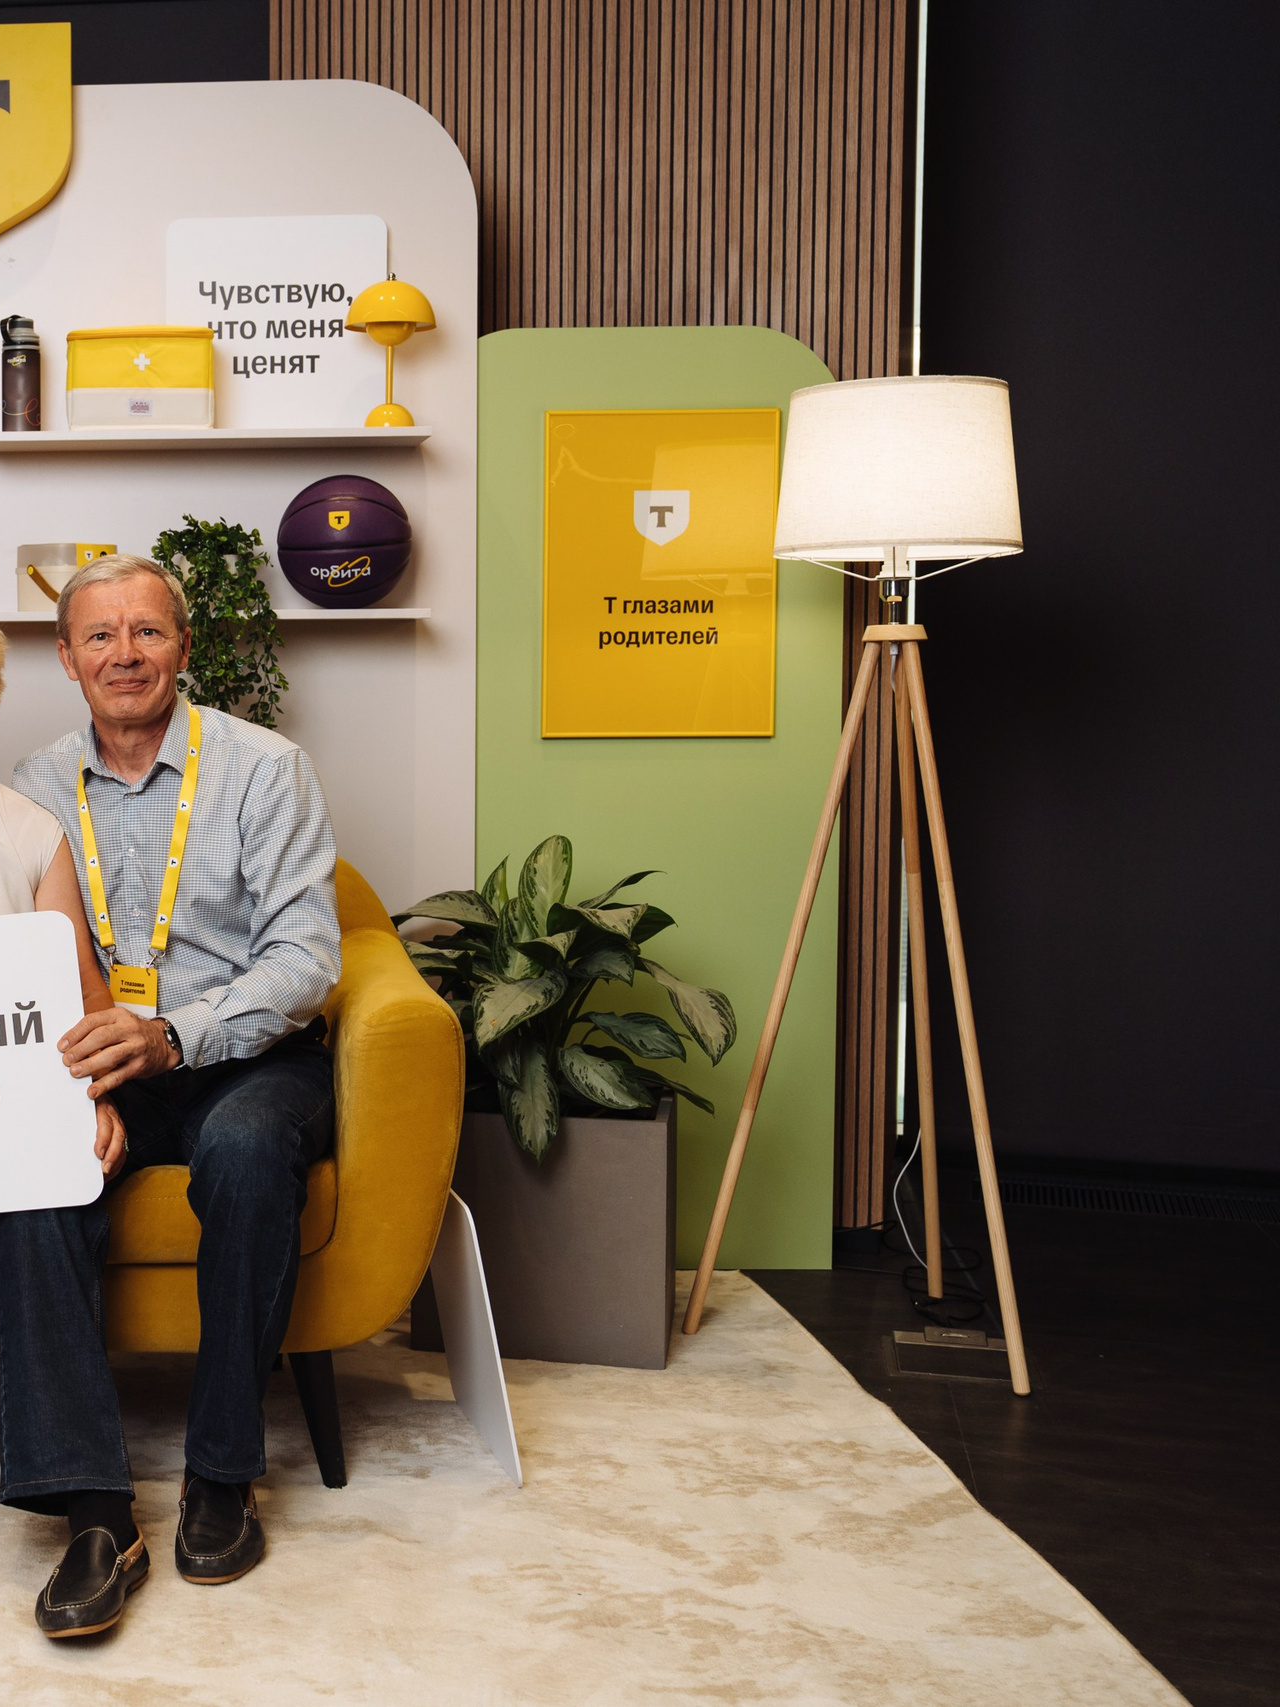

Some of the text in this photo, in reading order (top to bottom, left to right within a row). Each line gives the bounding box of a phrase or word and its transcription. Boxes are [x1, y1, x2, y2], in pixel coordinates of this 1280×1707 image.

[198, 281, 353, 311] Чувствую,
[265, 318, 344, 340] меня
[232, 354, 321, 379] ценят
[603, 596, 714, 615] Т глазами
[598, 626, 719, 650] родителей
